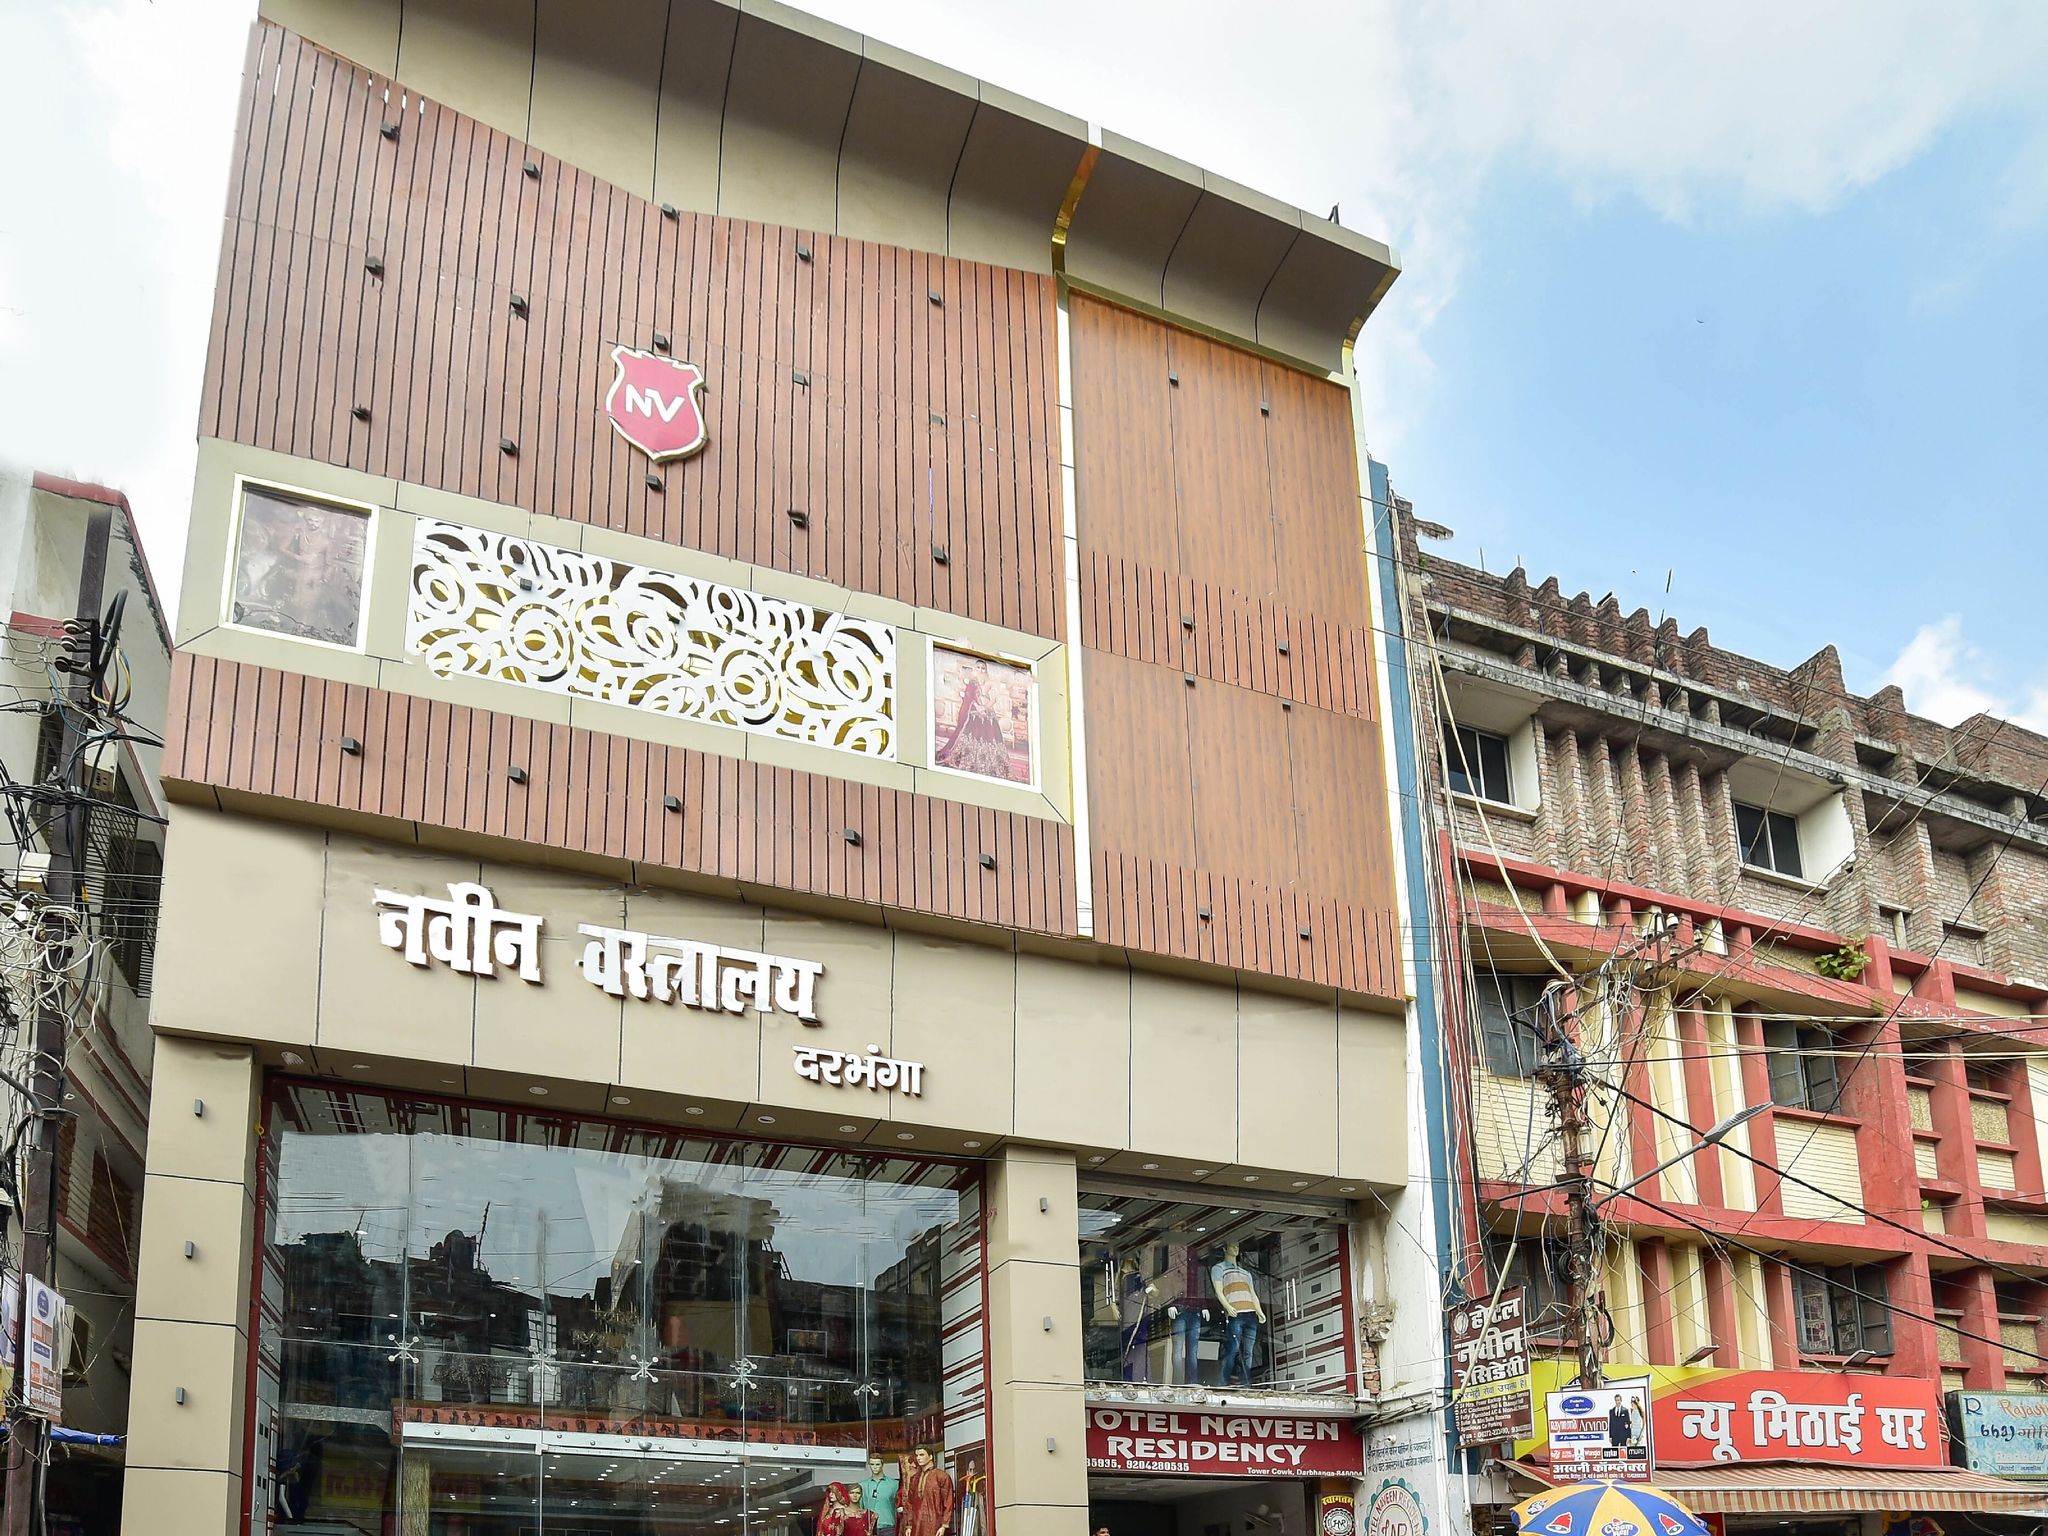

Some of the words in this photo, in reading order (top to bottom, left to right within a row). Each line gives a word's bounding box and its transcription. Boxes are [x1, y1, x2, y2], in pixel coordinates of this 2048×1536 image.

[625, 383, 686, 423] NV
[373, 882, 546, 984] नवीन
[792, 1043, 925, 1096] दरभंगा
[1453, 1326, 1524, 1364] नवीन
[1085, 1409, 1188, 1434] OTEL
[1200, 1415, 1339, 1441] NAVEEN
[1676, 1401, 1742, 1461] न्यू
[1747, 1390, 1865, 1455] मिठाई
[1875, 1407, 1927, 1449] घर
[1107, 1436, 1307, 1466] RESIDENCY
[1126, 1460, 1190, 1472] 9204280535
[1247, 1467, 1270, 1476] Tower
[1375, 1490, 1398, 1515] NAVEEN
